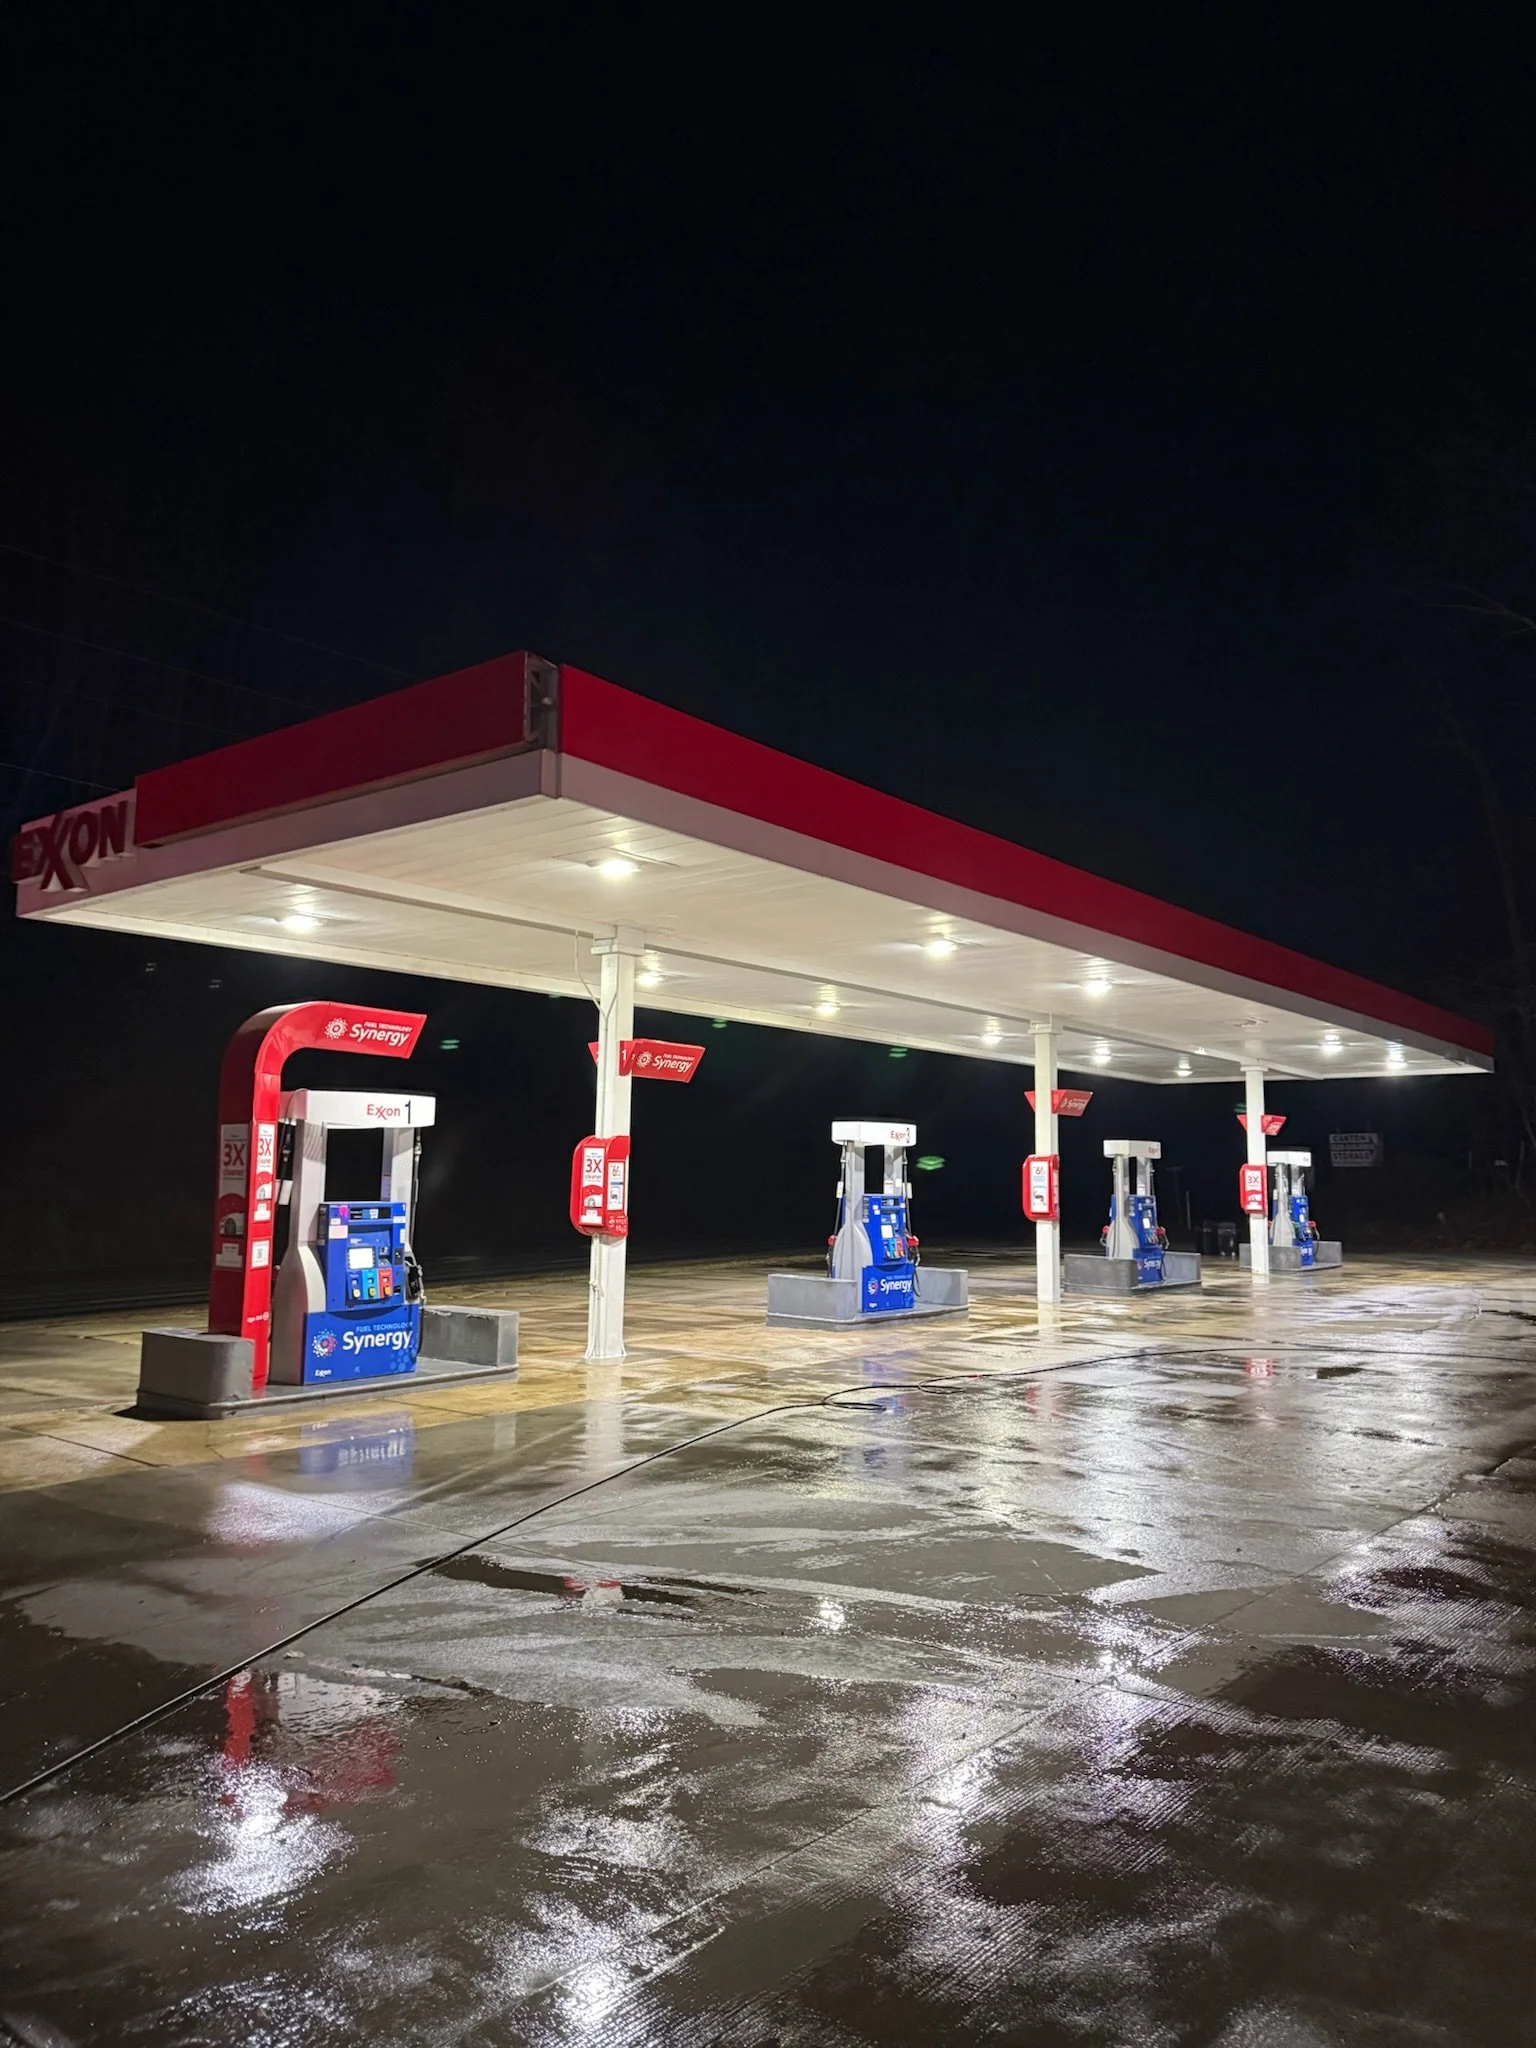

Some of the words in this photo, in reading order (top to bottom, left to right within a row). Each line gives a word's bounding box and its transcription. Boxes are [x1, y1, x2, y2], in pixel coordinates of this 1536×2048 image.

[12, 800, 129, 890] EXXON
[349, 1023, 410, 1047] Synergy
[364, 1021, 377, 1029] FUEL
[378, 1023, 413, 1033] TECHNOLOGY
[621, 1048, 627, 1061] 1
[652, 1055, 692, 1073] Synergy
[366, 1103, 400, 1120] Exxon
[404, 1099, 411, 1125] 1
[223, 1143, 245, 1167] 3X
[259, 1138, 272, 1156] 3X
[585, 1158, 602, 1173] 3X
[1247, 1175, 1260, 1184] 3X
[879, 1278, 913, 1295] Synergy
[356, 1325, 372, 1333] FUEL
[342, 1330, 414, 1355] Synergy
